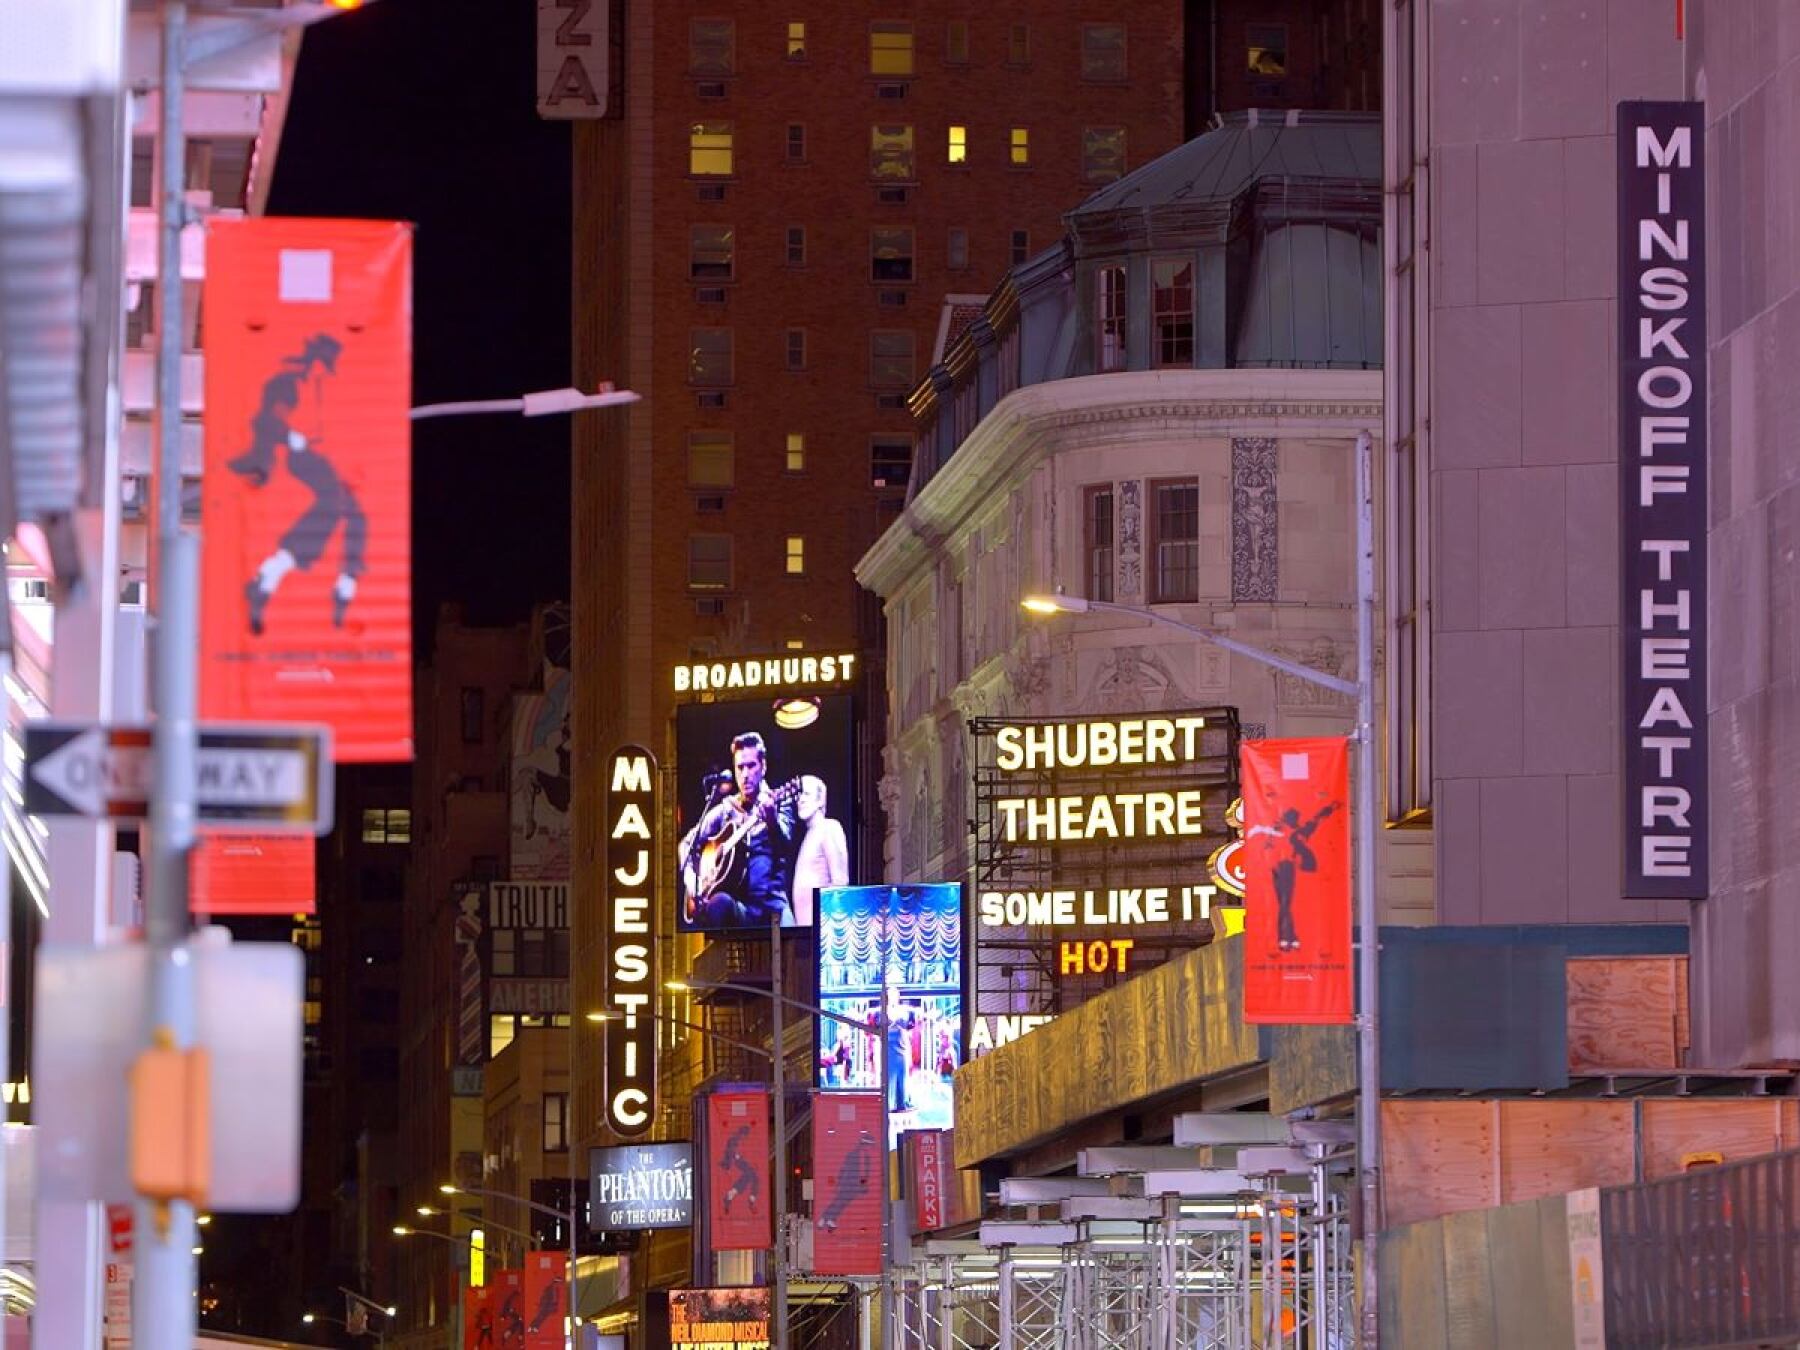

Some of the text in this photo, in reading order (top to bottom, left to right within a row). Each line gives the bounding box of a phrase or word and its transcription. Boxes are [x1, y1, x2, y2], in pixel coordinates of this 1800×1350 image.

[1636, 126, 1693, 877] MINSKOFF THEATRE
[674, 654, 855, 692] BROADHURST
[996, 717, 1205, 771] SHUBERT
[997, 790, 1202, 843] THEATRE
[494, 885, 567, 928] TRUTH
[981, 885, 1217, 926] SOME LIKE IT
[611, 756, 652, 1126] MAJESTIC
[1060, 939, 1134, 975] HOT
[639, 1152, 654, 1164] THE
[599, 1167, 693, 1204] PHANTOM
[923, 1155, 937, 1212] PARK
[611, 1208, 682, 1225] OF THE OPERA
